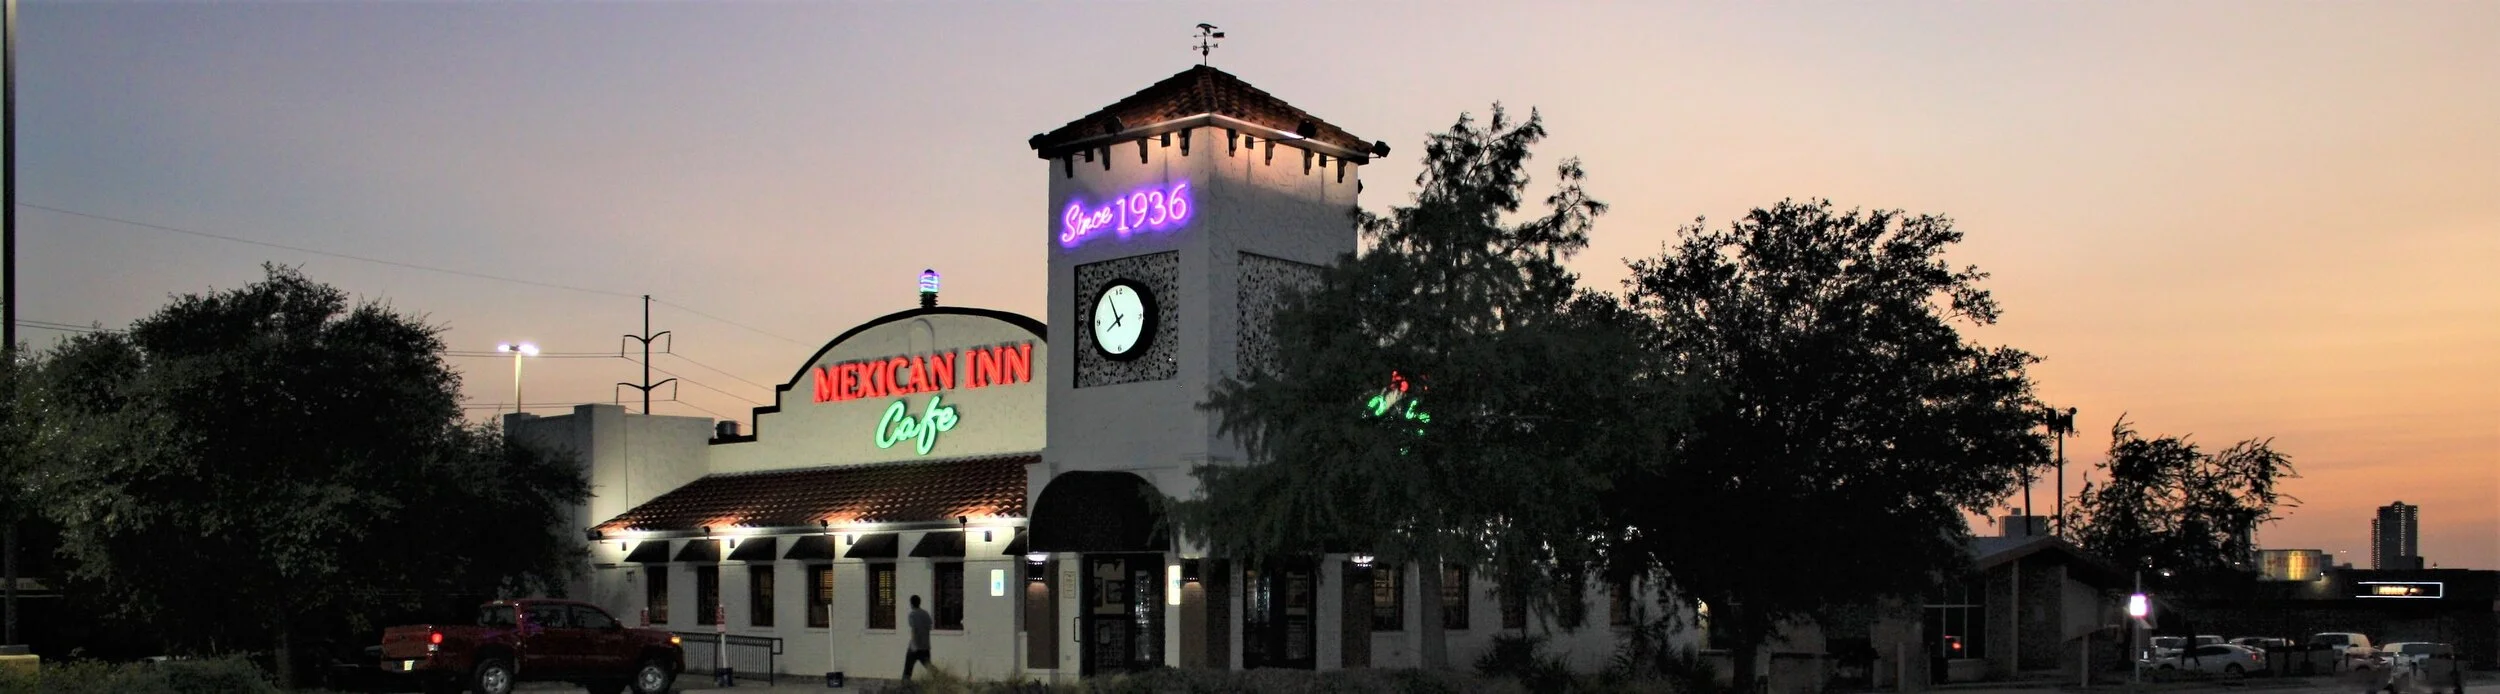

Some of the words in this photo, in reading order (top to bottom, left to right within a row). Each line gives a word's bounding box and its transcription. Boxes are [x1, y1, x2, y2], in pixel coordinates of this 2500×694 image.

[1060, 203, 1113, 243] Since
[1115, 183, 1187, 231] 1936
[1115, 287, 1123, 296] 12
[813, 352, 957, 403] MEXICAN
[964, 343, 1032, 388] INN
[875, 395, 959, 455] Cafe
